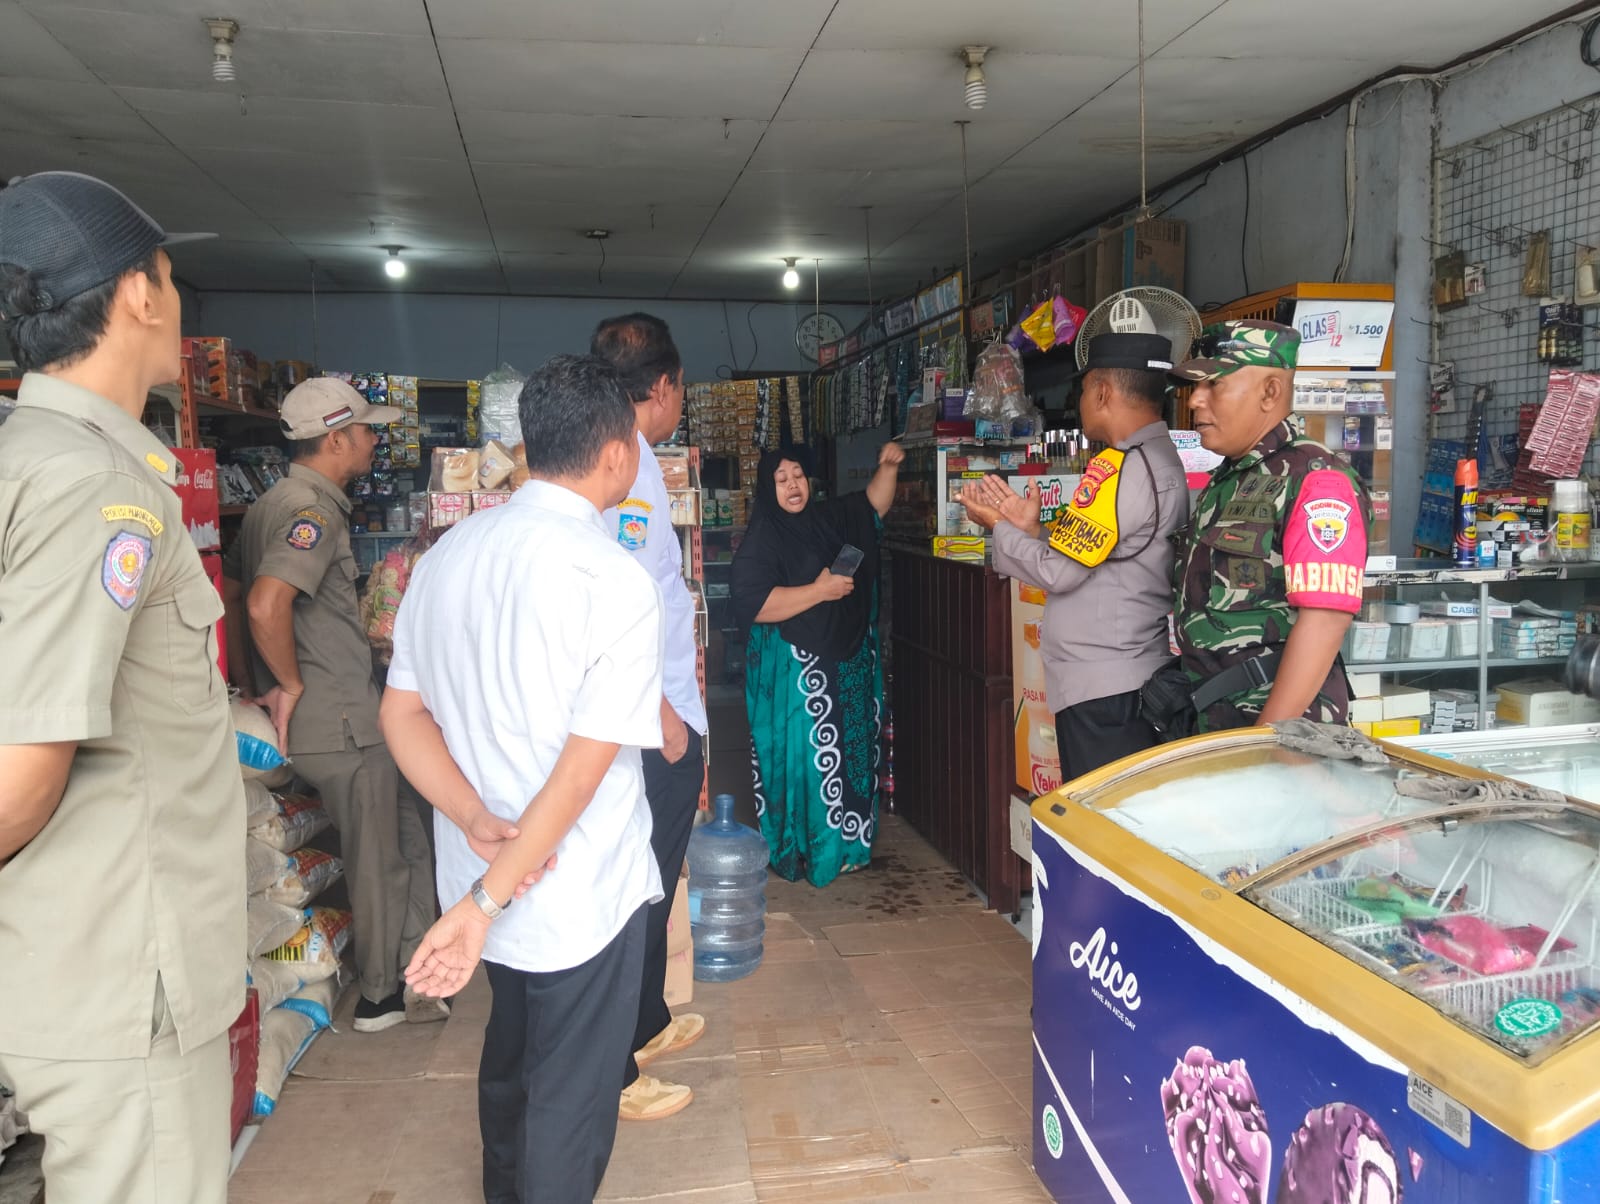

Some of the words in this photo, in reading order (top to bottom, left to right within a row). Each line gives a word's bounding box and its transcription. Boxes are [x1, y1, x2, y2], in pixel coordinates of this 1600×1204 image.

[1303, 318, 1327, 340] CLAS
[1356, 324, 1384, 334] 1.500
[1330, 334, 1342, 347] 12
[1070, 927, 1141, 1010] Aice
[1413, 1078, 1432, 1098] AICE
